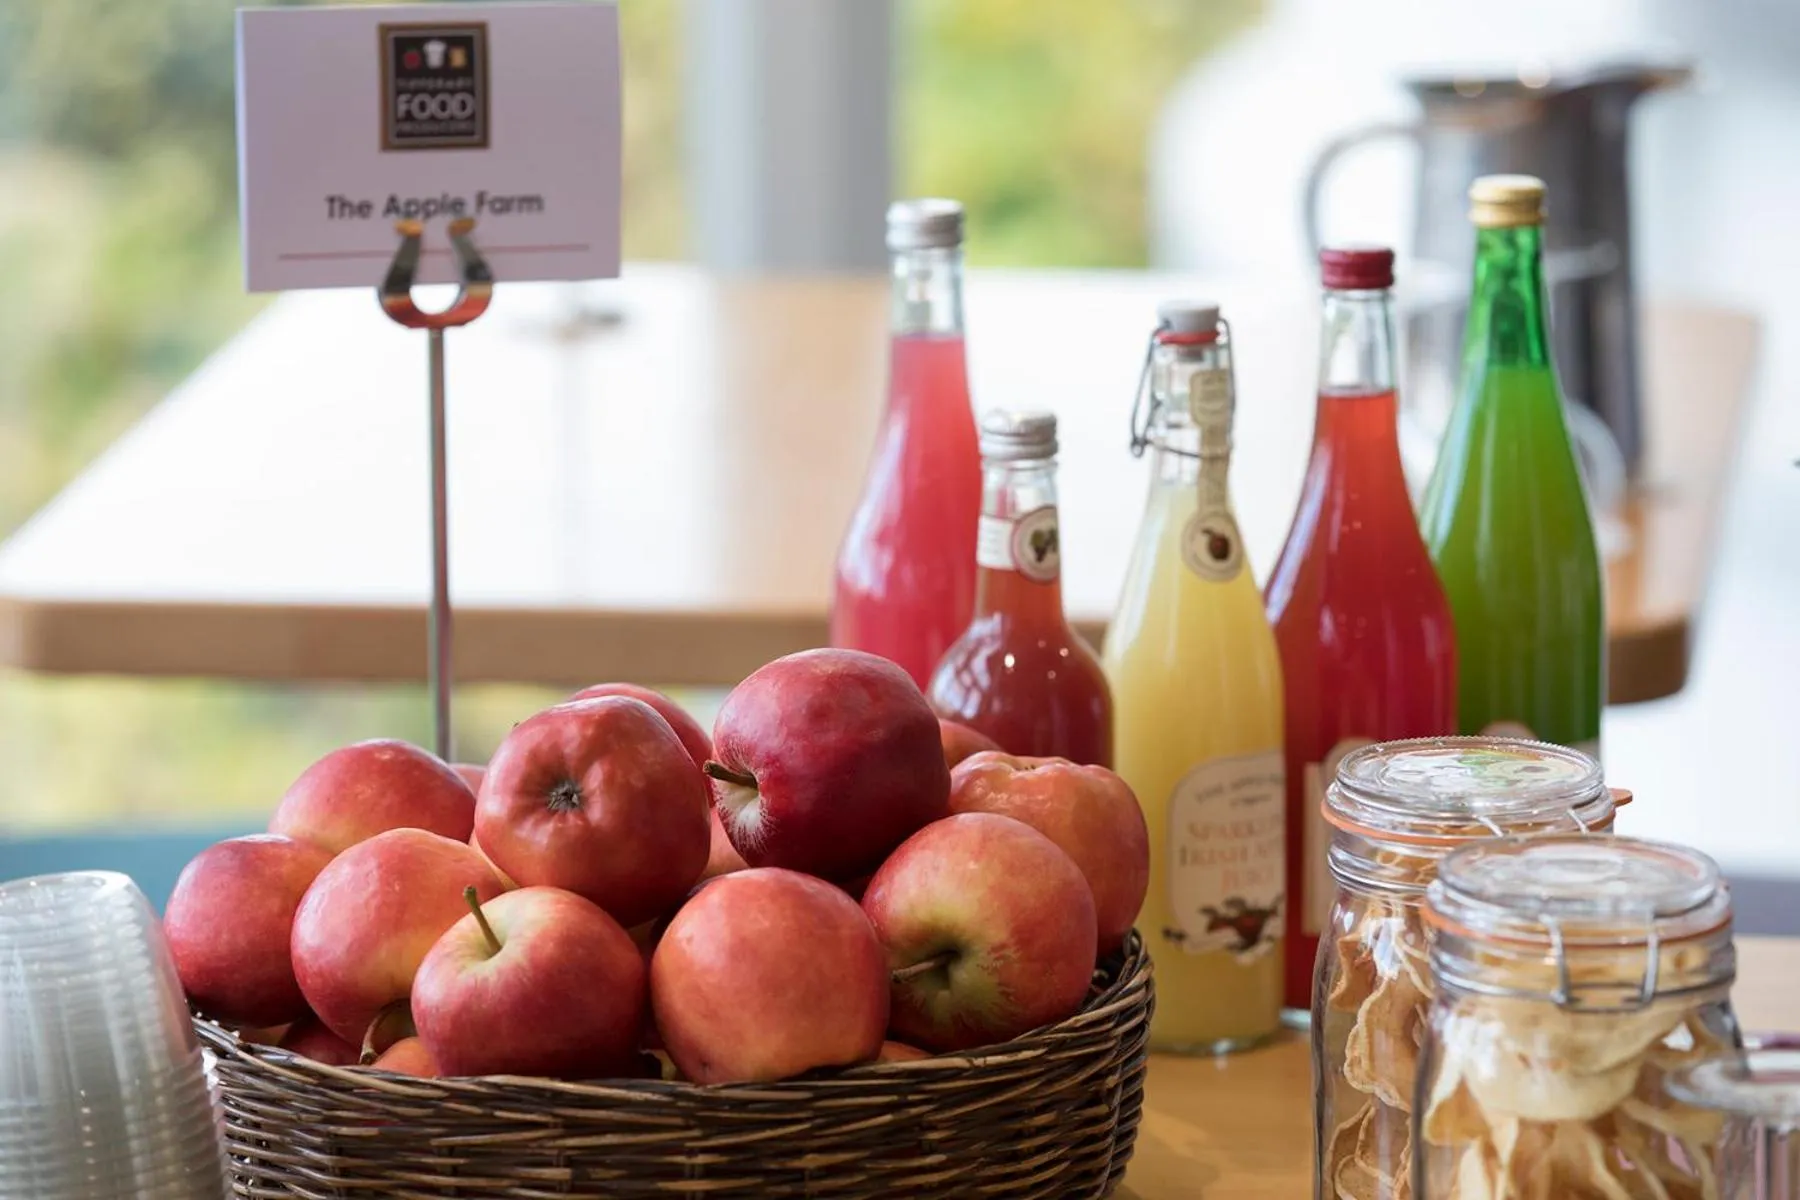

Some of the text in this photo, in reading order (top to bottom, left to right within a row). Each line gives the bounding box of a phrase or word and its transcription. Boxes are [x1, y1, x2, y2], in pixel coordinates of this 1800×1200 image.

[397, 92, 475, 120] FOOD
[326, 190, 545, 221] The Apple Farm
